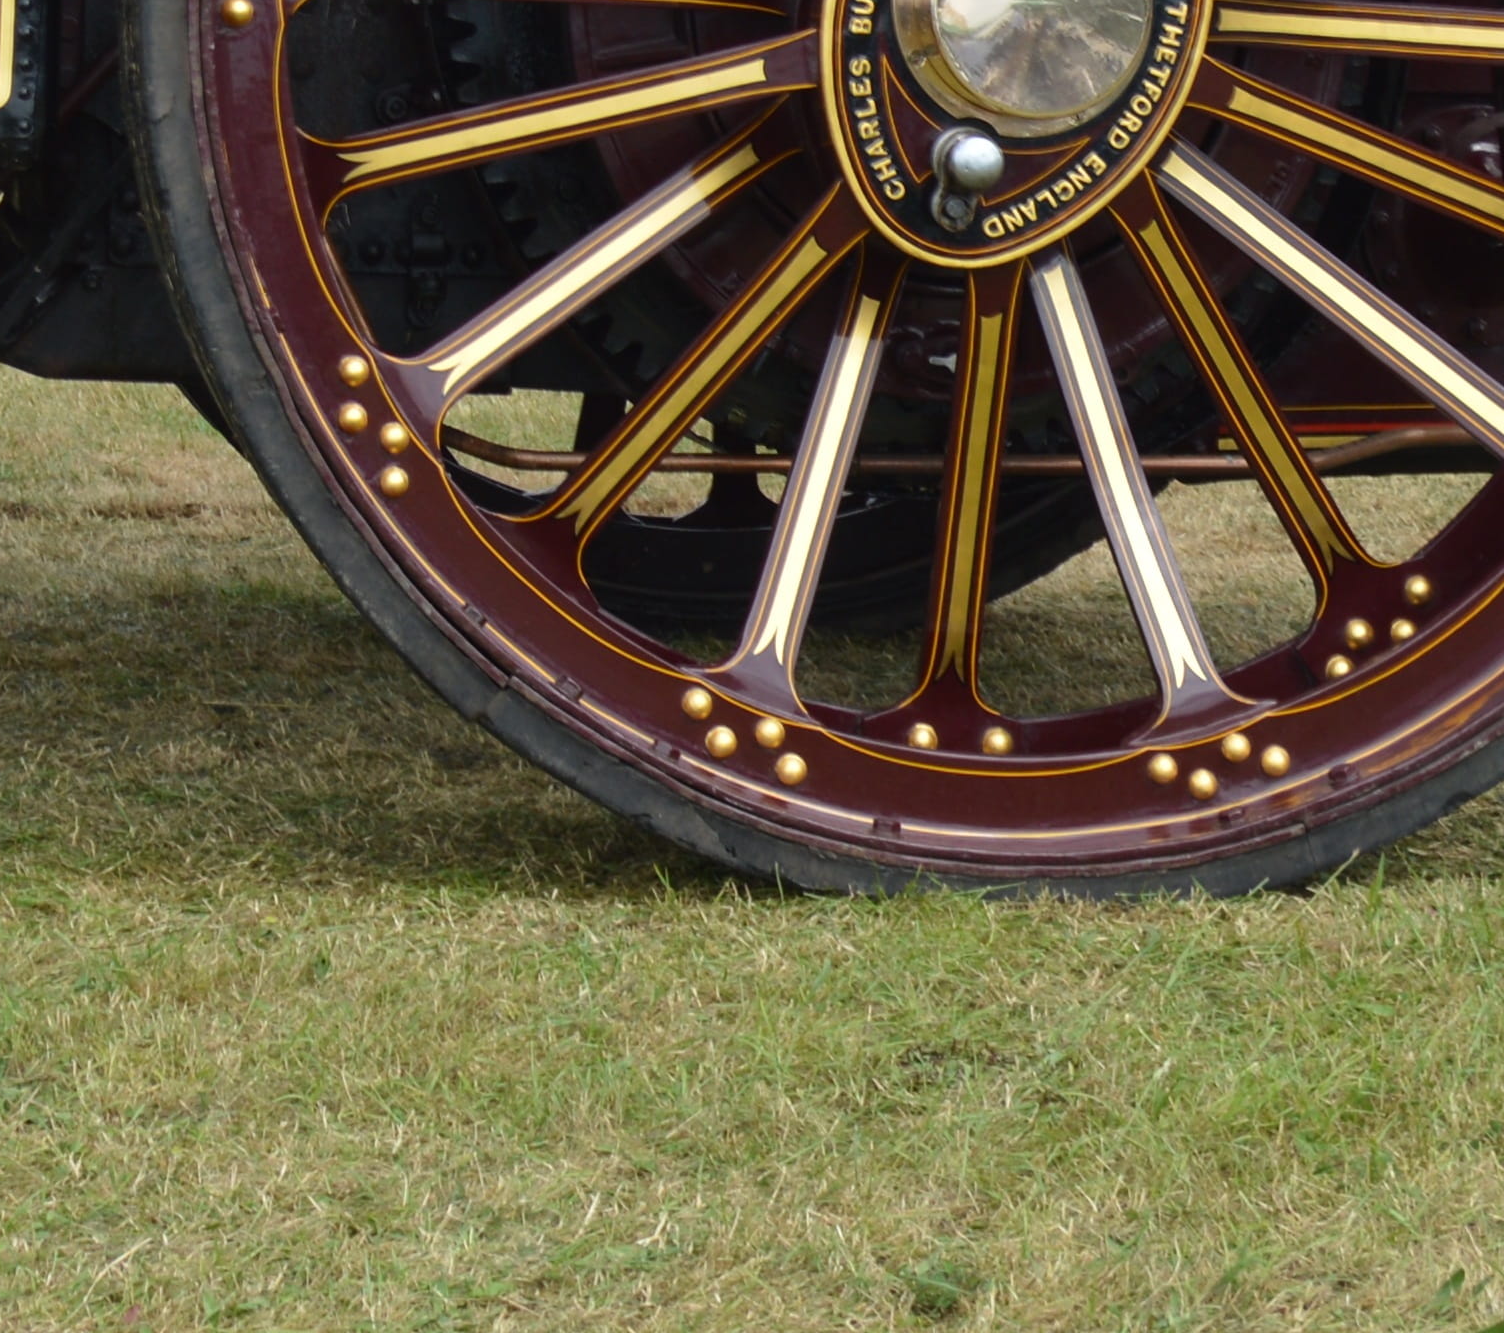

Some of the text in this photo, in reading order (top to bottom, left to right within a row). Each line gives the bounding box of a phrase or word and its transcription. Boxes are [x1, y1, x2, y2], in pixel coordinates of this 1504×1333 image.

[848, 54, 907, 201] CHARLES
[1109, 2, 1188, 150] THETFORD
[982, 151, 1108, 238] ENGLAND
